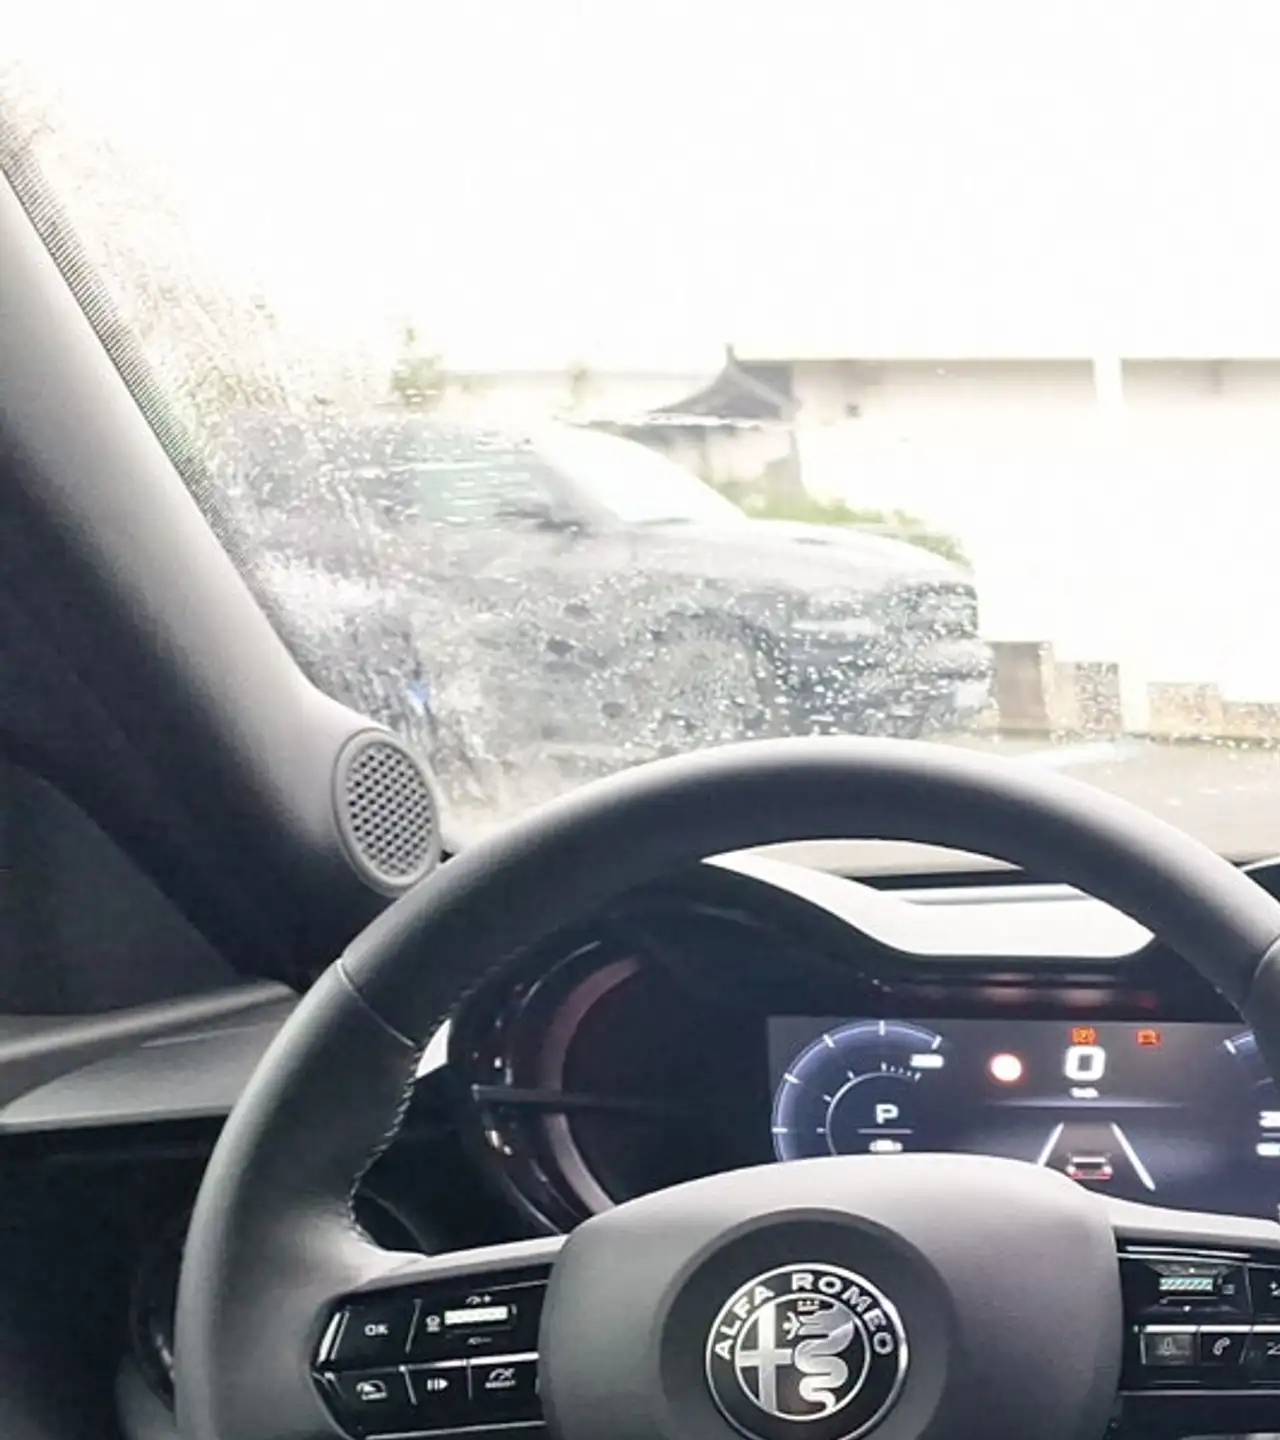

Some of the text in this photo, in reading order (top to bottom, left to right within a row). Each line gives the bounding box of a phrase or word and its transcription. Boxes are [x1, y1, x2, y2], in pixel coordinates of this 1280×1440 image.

[875, 1103, 899, 1124] P
[713, 1272, 894, 1361] ALFA ROMEO
[364, 1323, 389, 1337] OK
